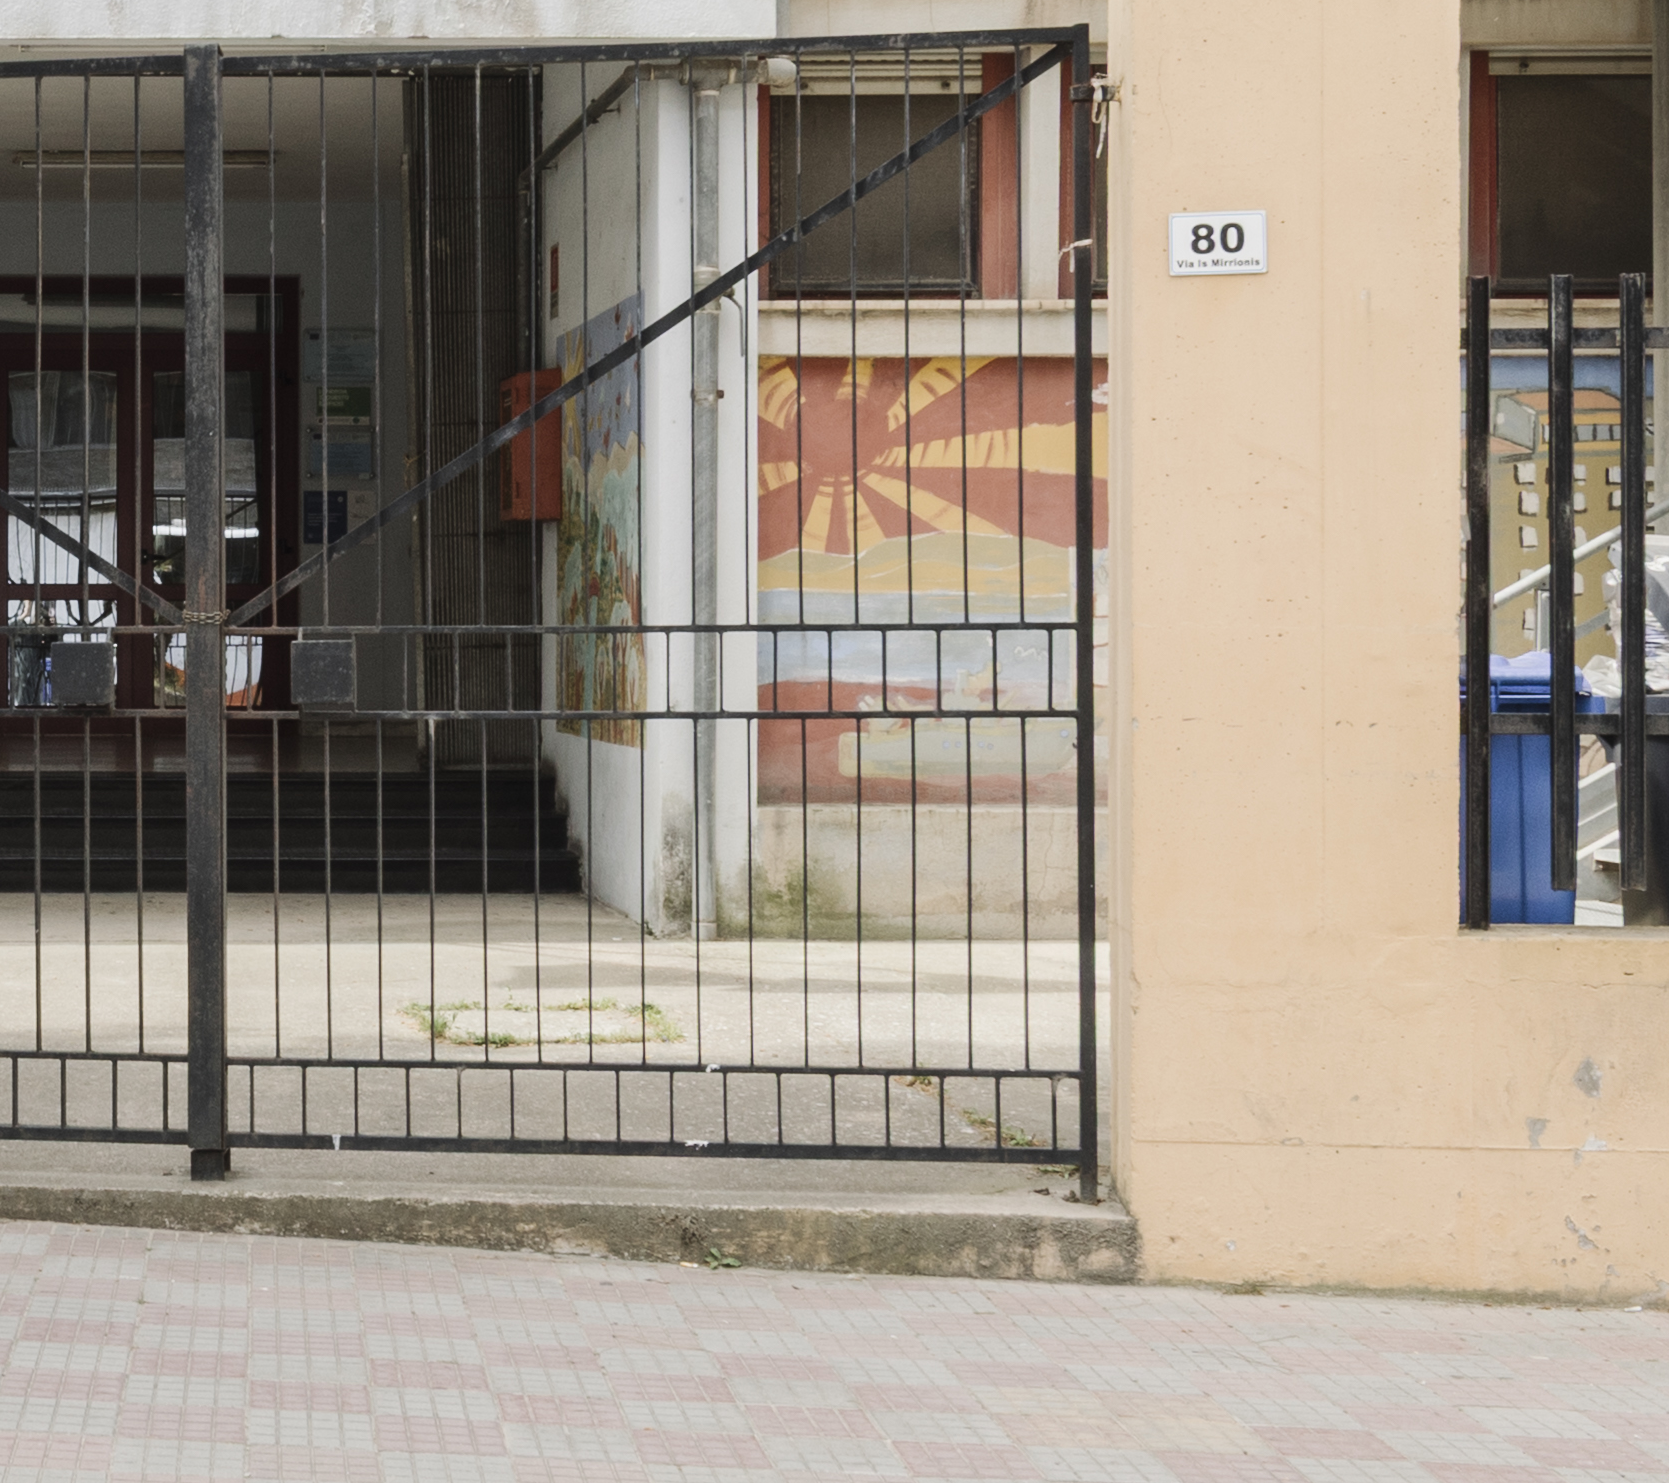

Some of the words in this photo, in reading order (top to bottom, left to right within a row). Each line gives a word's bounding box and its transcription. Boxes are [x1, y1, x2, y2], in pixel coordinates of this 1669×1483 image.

[1191, 222, 1245, 255] 80
[1177, 259, 1195, 269] Via
[1211, 257, 1261, 267] Mirrionis
